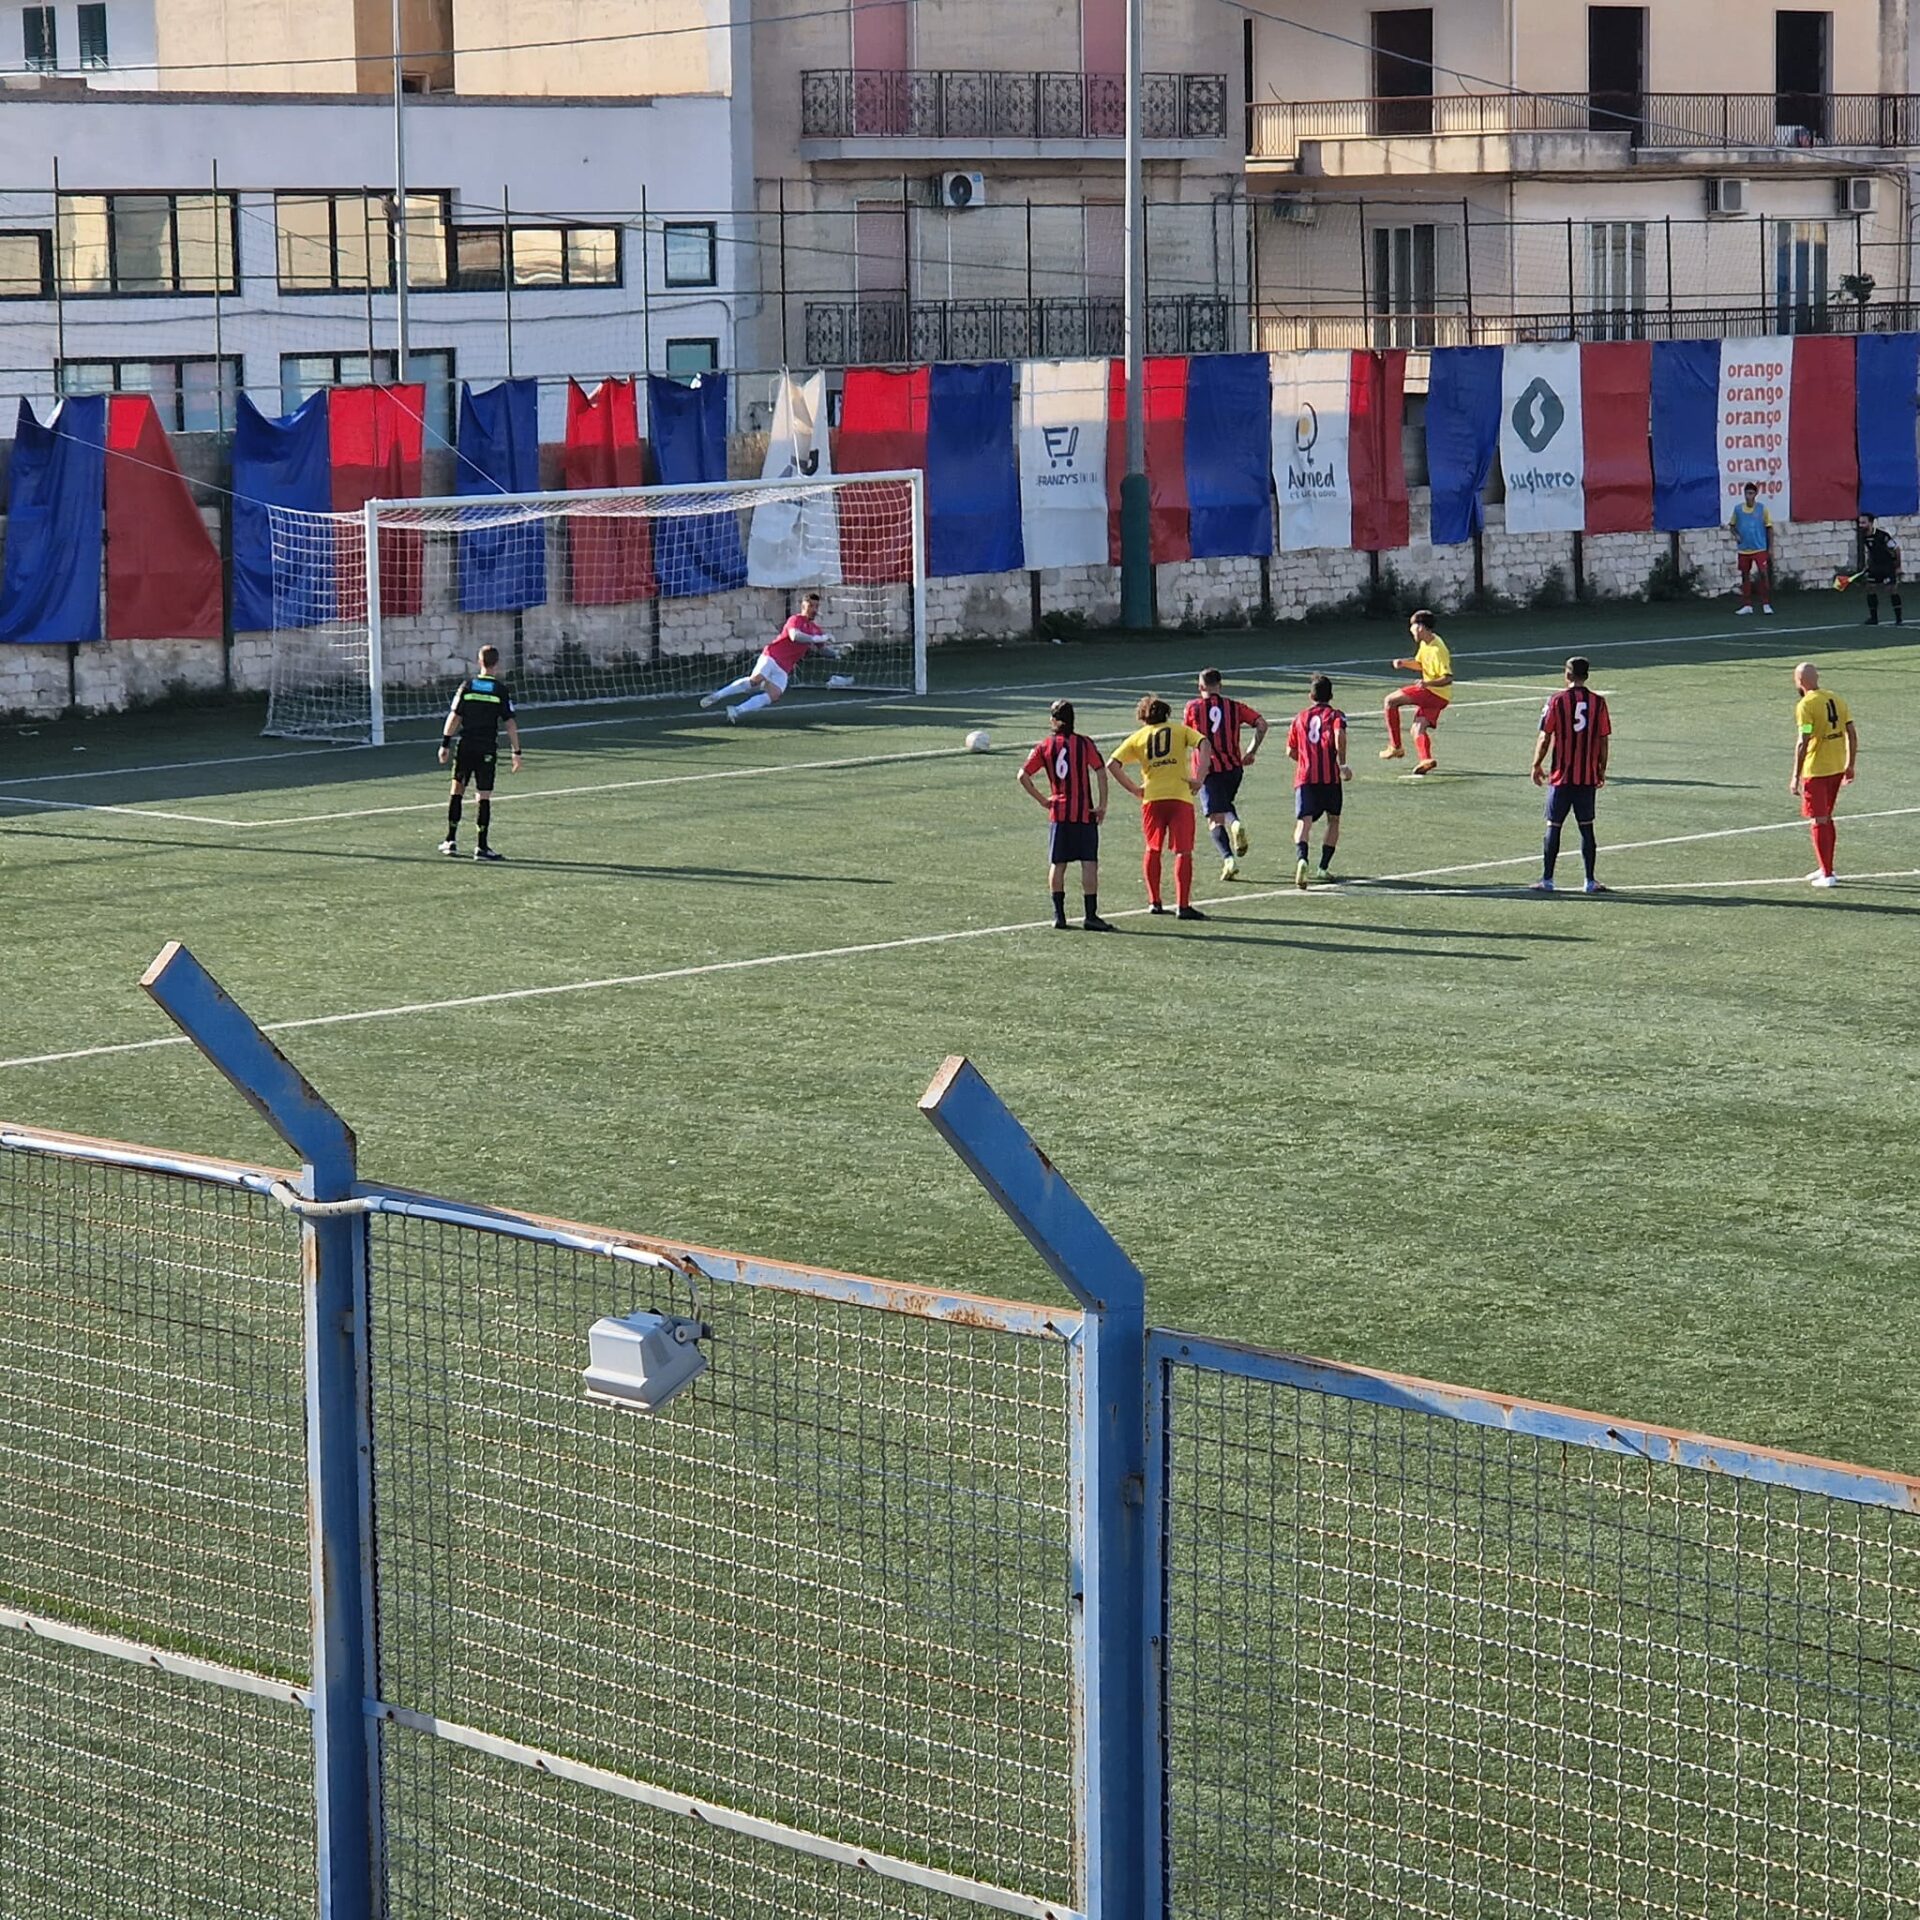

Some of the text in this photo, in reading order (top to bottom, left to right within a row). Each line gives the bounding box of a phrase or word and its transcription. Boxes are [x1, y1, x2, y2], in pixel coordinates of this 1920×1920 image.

[1727, 362, 1783, 381] orango
[1726, 386, 1783, 405] orango
[1725, 410, 1782, 429] orango
[1725, 433, 1783, 452] orango
[1726, 457, 1782, 476] orango
[1510, 467, 1575, 494] sughero
[1727, 480, 1782, 499] orngo
[1209, 706, 1222, 734] 9
[1573, 701, 1588, 732] 5
[1825, 698, 1838, 729] 4
[1308, 715, 1321, 744] 8
[1147, 727, 1171, 760] 10
[1055, 747, 1068, 780] 6
